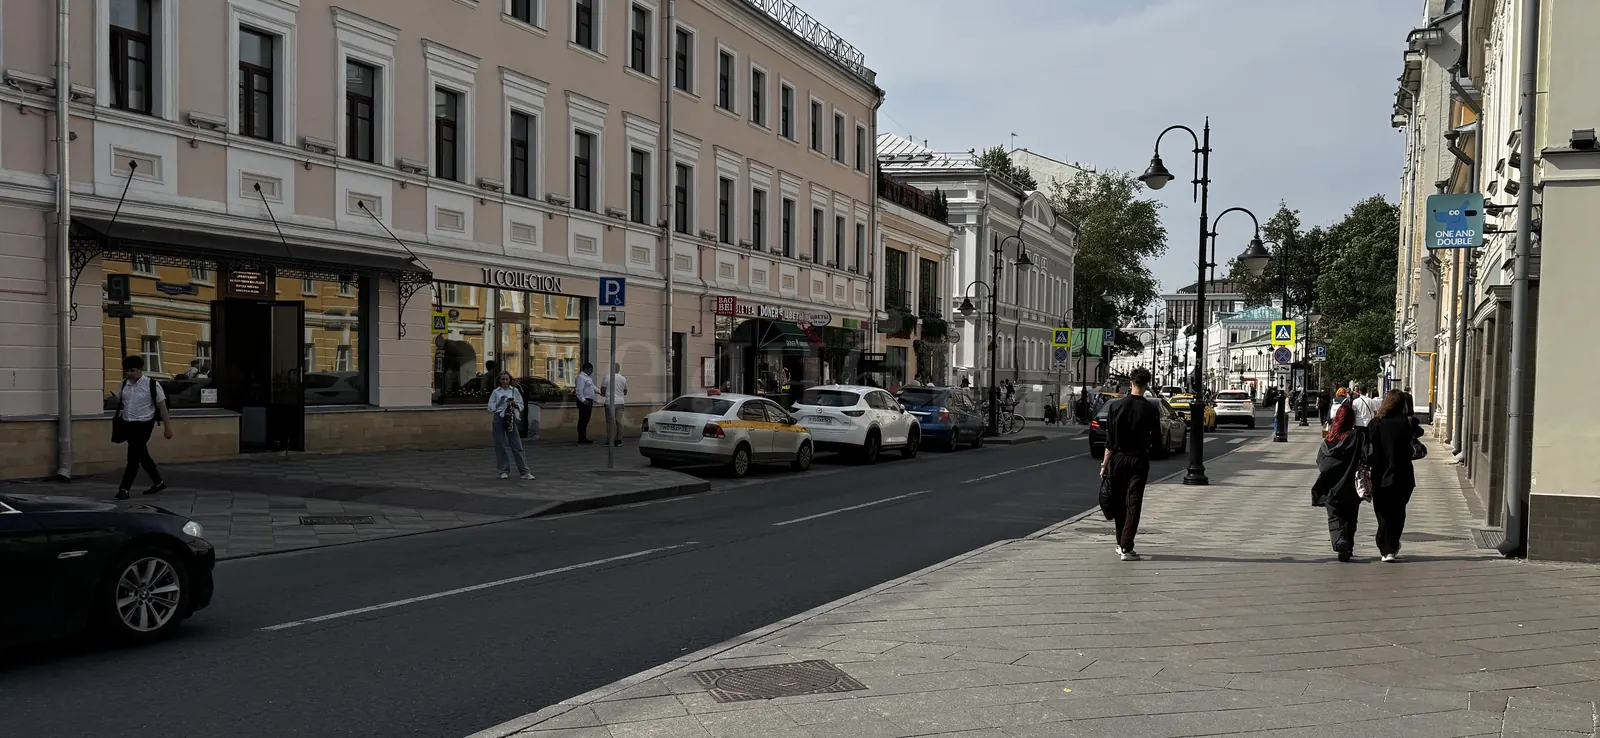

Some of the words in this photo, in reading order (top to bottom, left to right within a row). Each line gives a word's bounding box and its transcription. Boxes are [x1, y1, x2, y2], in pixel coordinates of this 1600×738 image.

[495, 270, 562, 292] COLLECTION
[605, 280, 620, 303] P
[784, 310, 804, 321] ЦВЕТЫ
[1106, 331, 1112, 339] P
[1317, 346, 1324, 355] P
